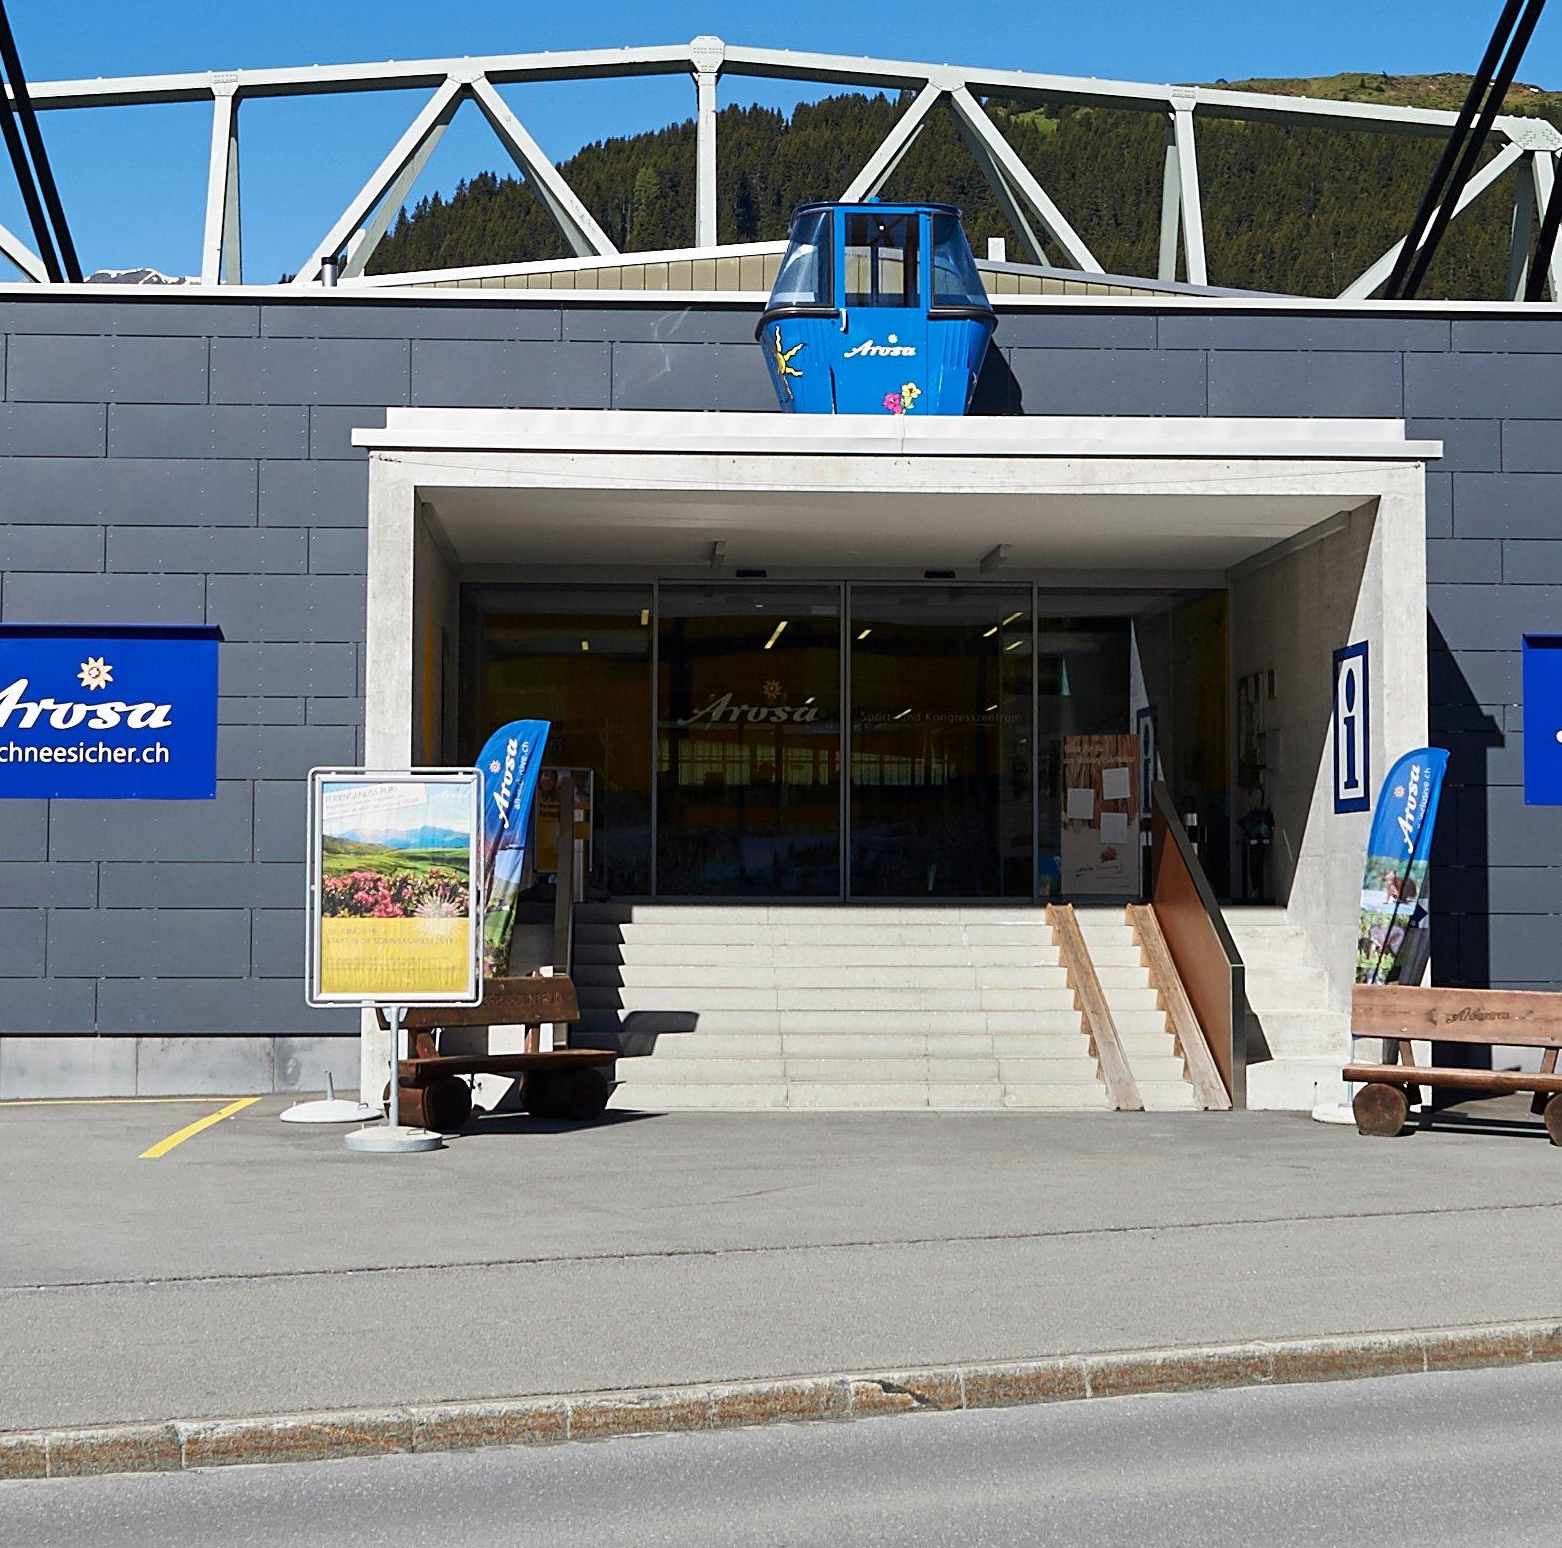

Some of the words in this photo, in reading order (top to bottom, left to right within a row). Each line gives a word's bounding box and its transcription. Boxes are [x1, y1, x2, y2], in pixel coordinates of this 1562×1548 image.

[844, 340, 916, 358] Arosa
[677, 692, 819, 726] Arosa
[925, 711, 1021, 725] Kongresszentrum
[493, 738, 518, 829] Arosa
[1398, 763, 1421, 854] Arosa
[1445, 1007, 1510, 1024] Arosa
